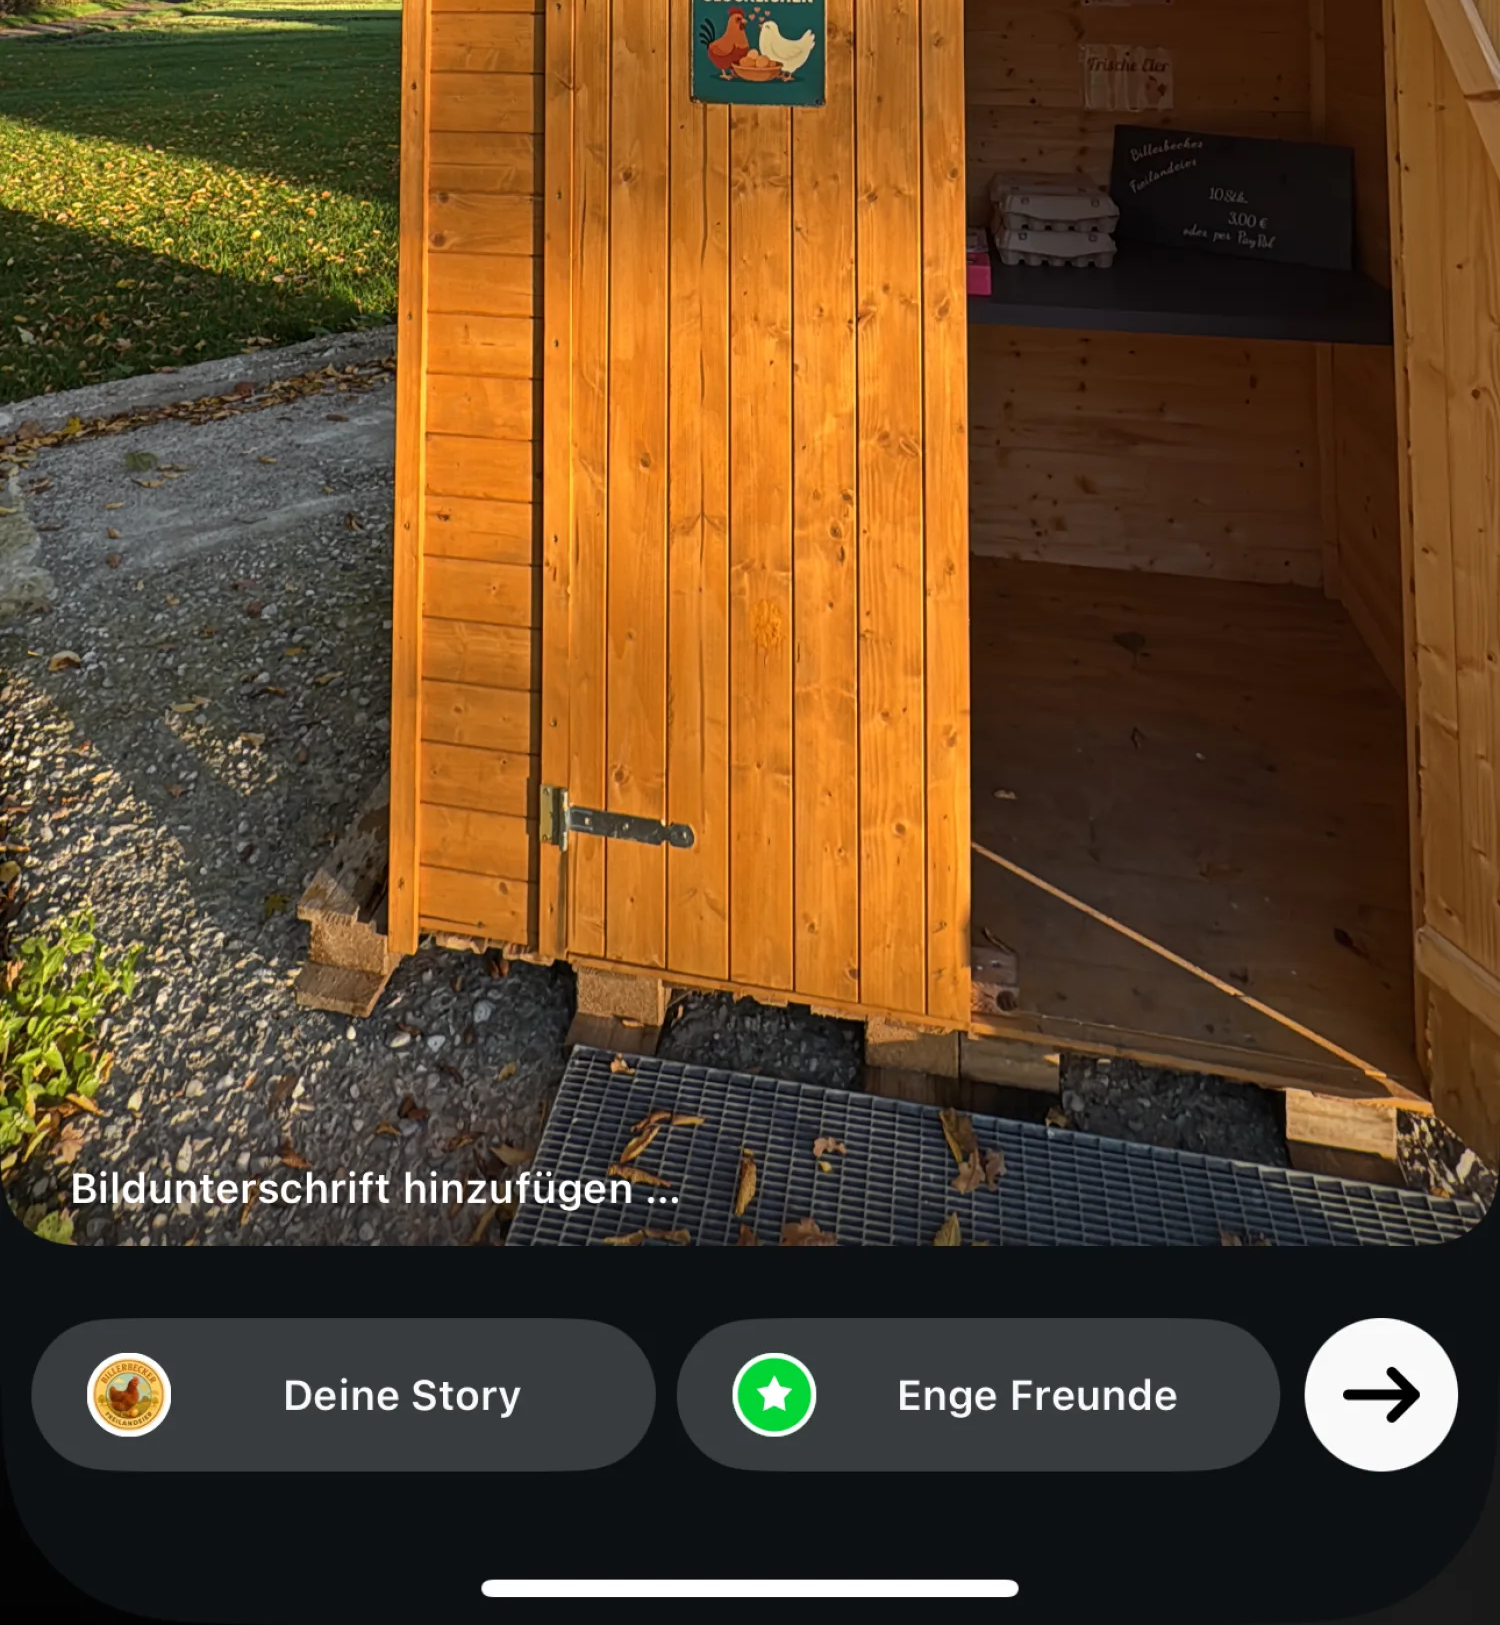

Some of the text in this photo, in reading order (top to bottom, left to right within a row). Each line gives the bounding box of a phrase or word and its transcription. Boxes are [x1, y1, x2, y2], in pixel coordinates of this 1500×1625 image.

[1130, 137, 1204, 162] Billerbecker
[1129, 159, 1197, 194] Freilandeier
[1182, 223, 1208, 238] oder
[1212, 232, 1231, 243] per
